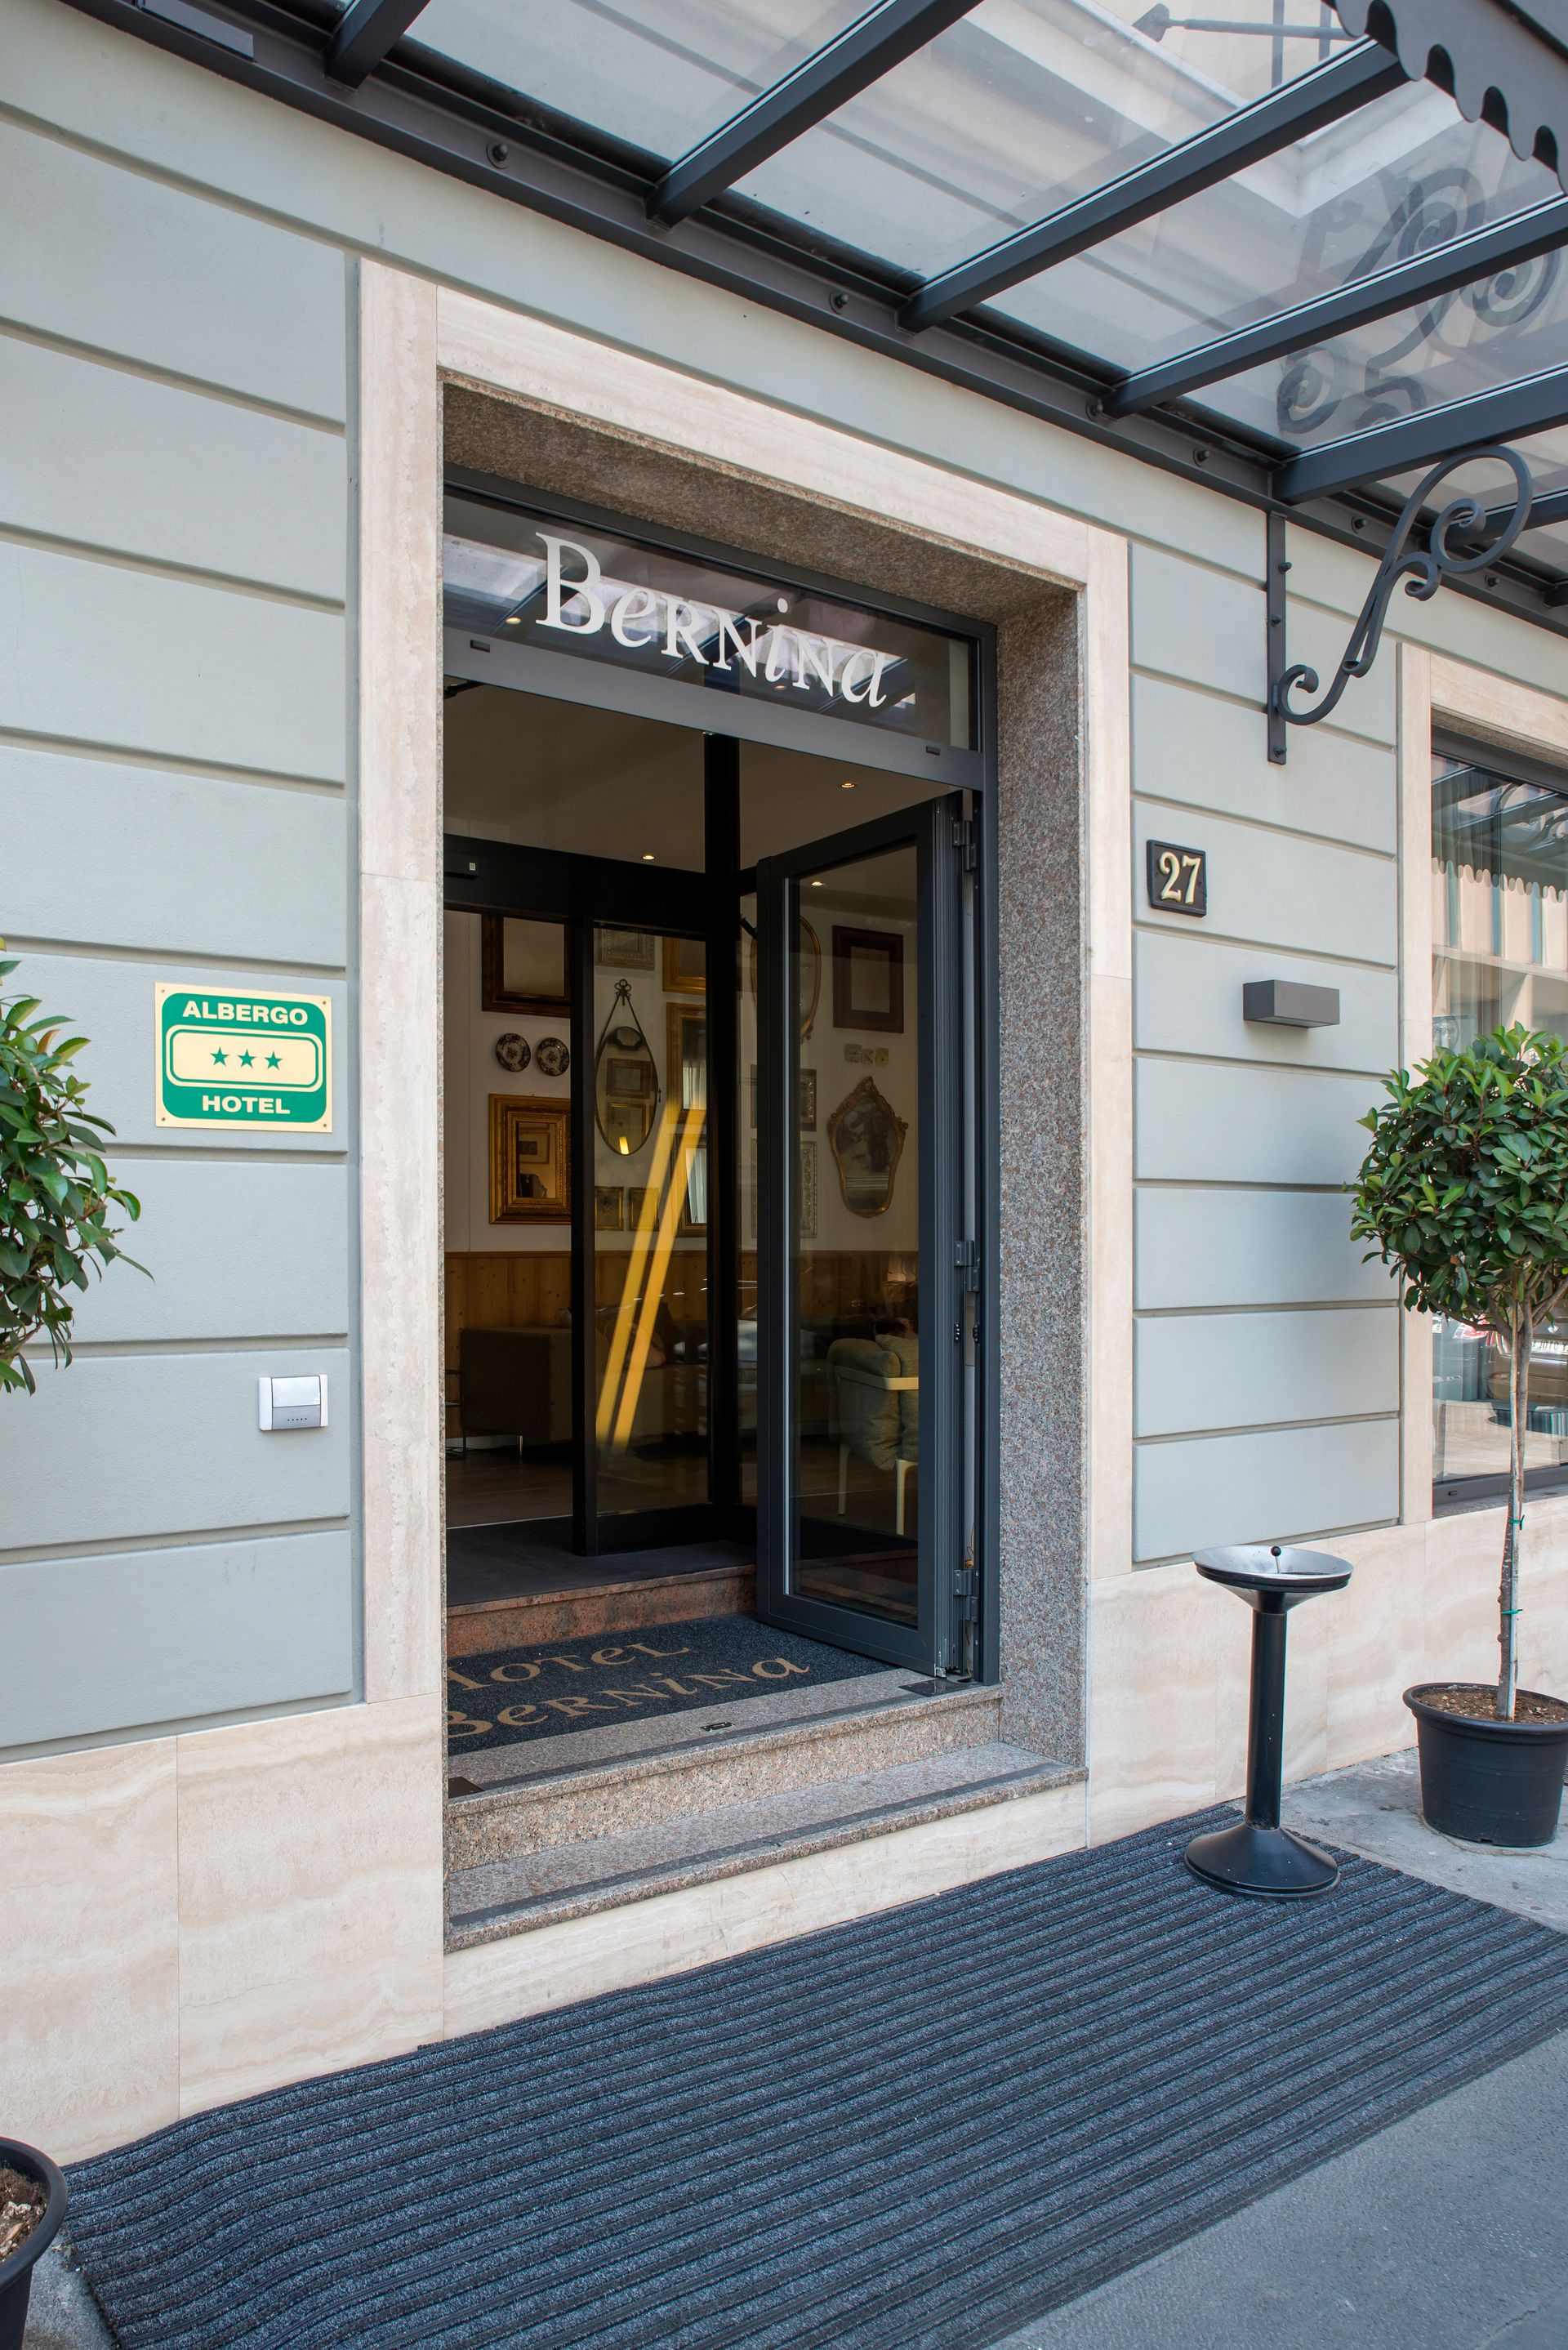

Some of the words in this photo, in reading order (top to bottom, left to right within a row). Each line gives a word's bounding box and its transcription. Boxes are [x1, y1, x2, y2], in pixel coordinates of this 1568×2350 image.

[1159, 851, 1201, 905] 27
[181, 1000, 309, 1026] ALBERGO
[202, 1095, 291, 1115] HOTEL
